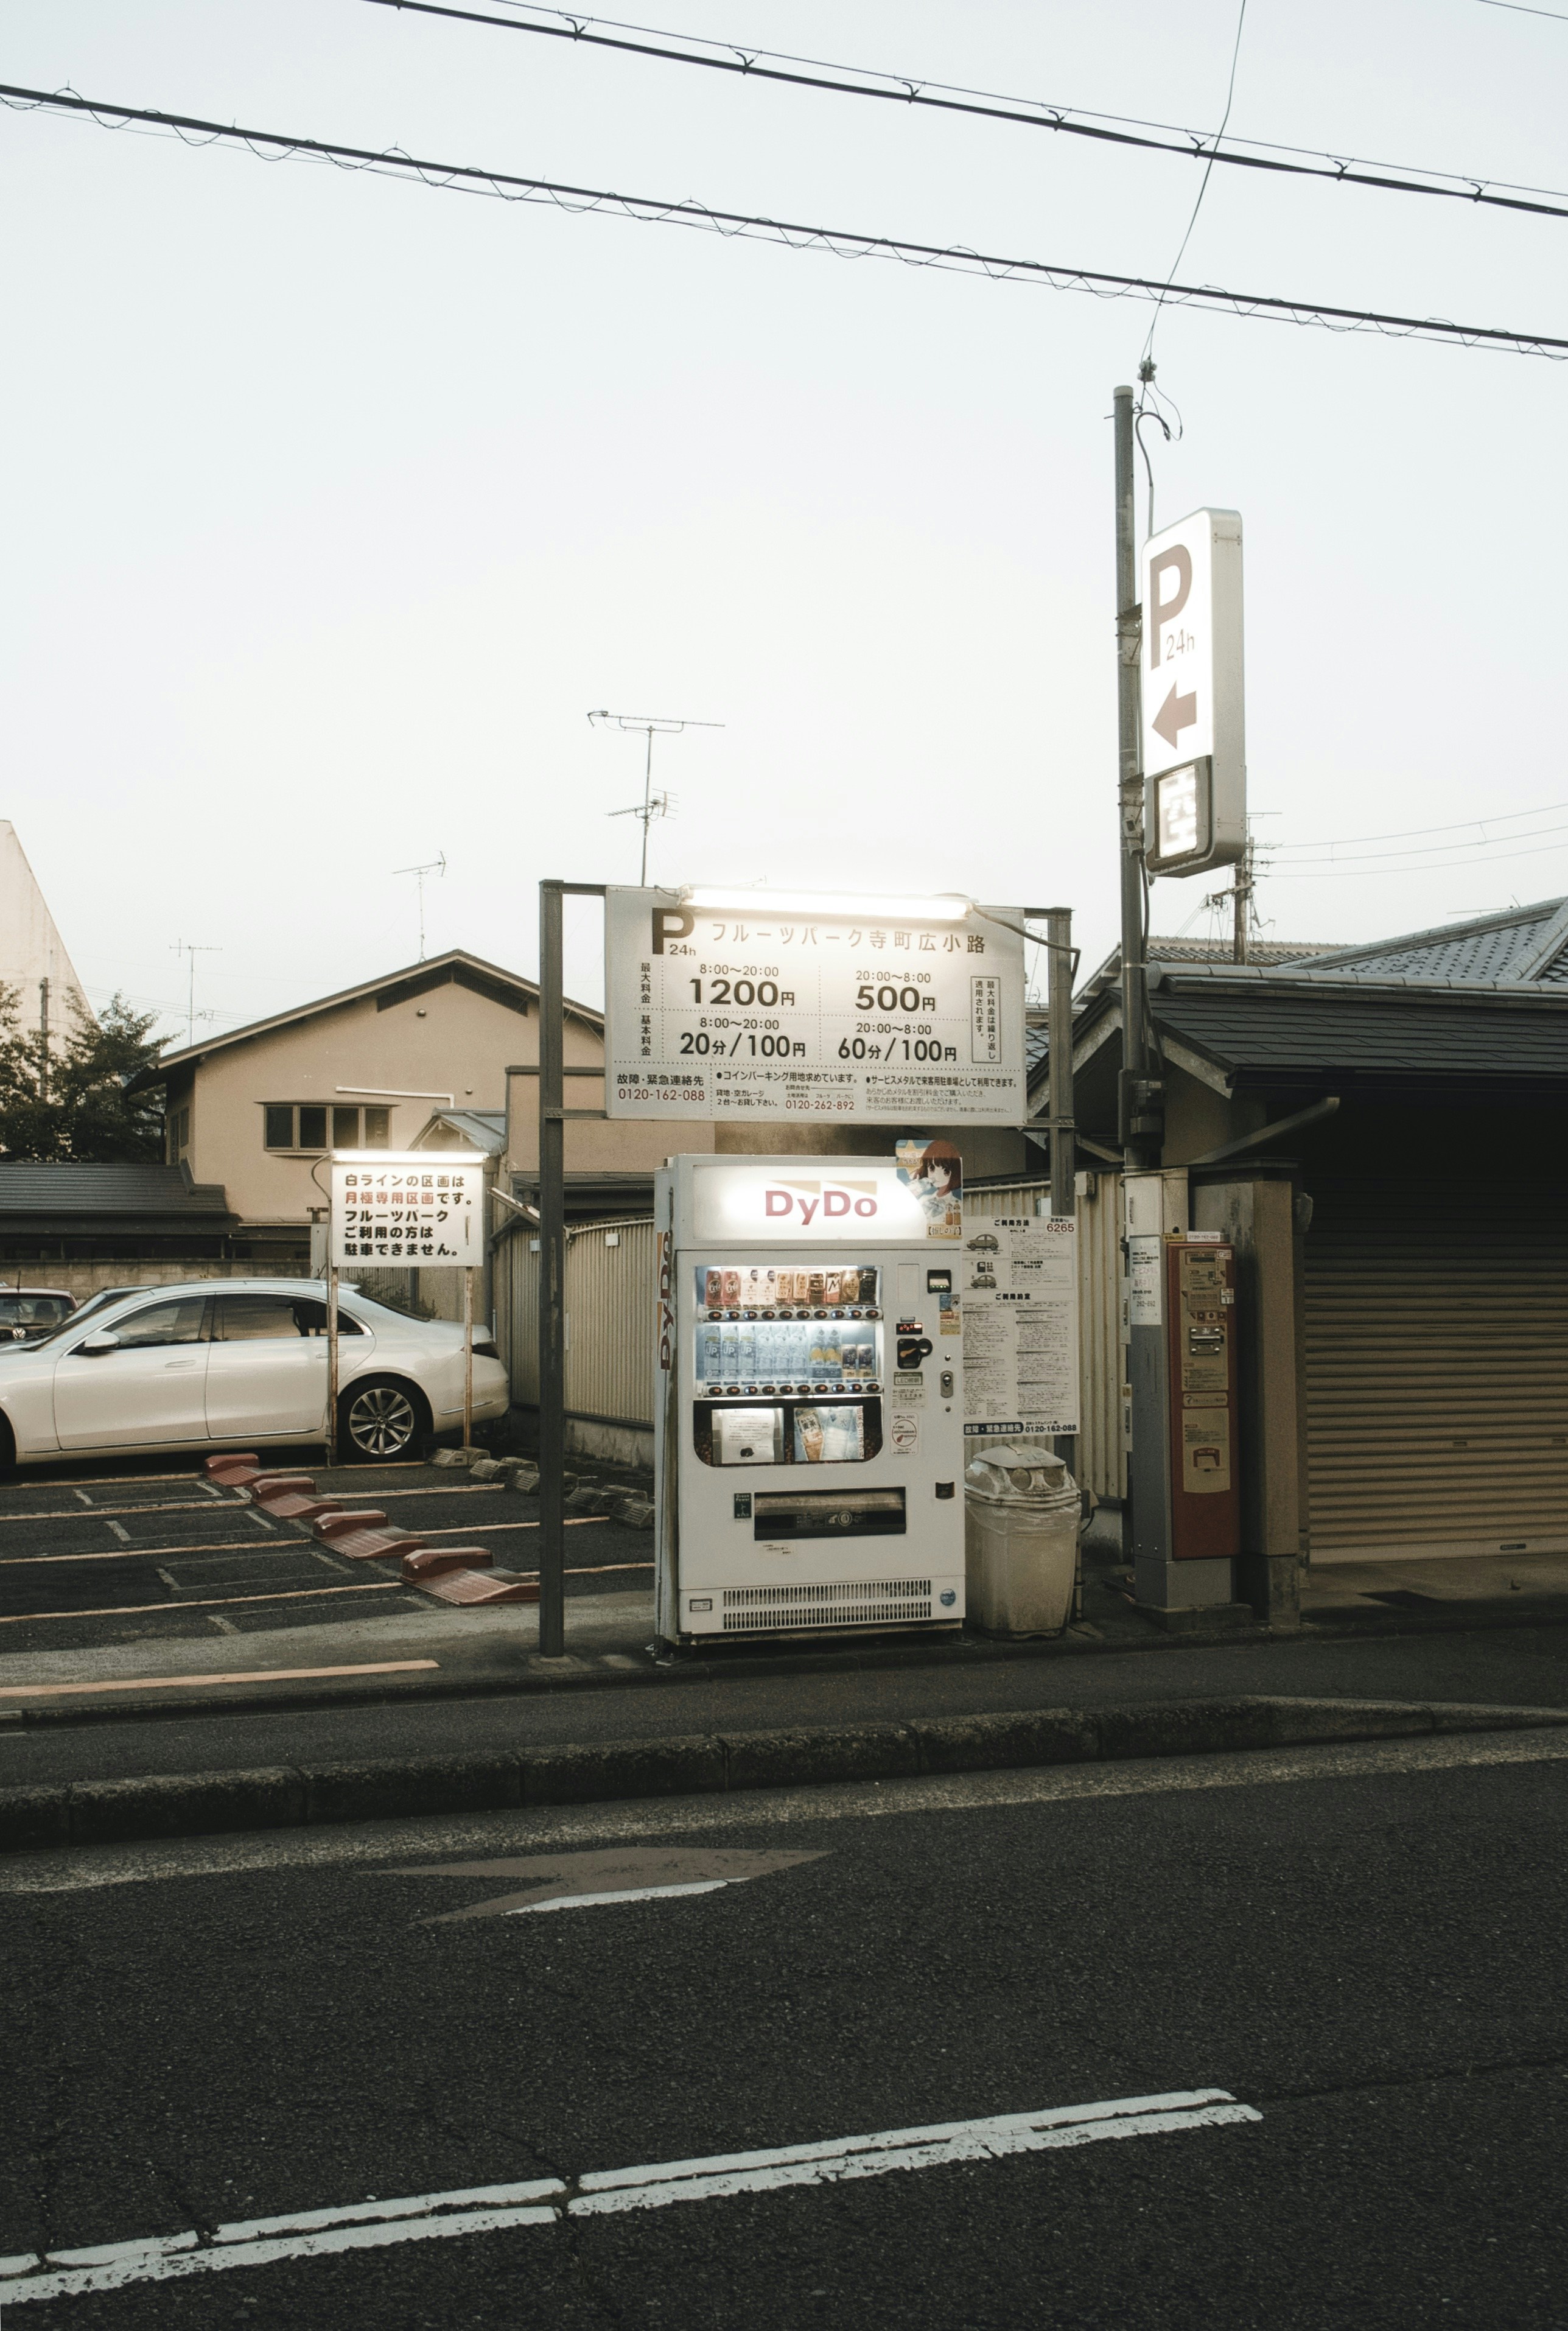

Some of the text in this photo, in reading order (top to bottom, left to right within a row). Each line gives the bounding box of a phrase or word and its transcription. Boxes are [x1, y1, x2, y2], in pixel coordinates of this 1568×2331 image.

[1149, 544, 1192, 671] P
[1166, 628, 1195, 661] 24h
[652, 907, 695, 955] P
[712, 922, 985, 955] フルーツパーク寺町広小路
[670, 944, 696, 956] 24h
[641, 962, 651, 1004] 最大料金
[689, 979, 795, 1008] 1200円
[855, 985, 936, 1013] 500円
[641, 1015, 651, 1056] 基本料金
[617, 1074, 704, 1086] 故障・緊急連絡先
[618, 1088, 705, 1101] 0120-162-088
[786, 1100, 855, 1110] 0120-262-892
[345, 1174, 464, 1188] 白ラインの区画は
[345, 1191, 471, 1205] 月極専用区画です。
[766, 1190, 878, 1225] DyDo
[345, 1208, 448, 1222] フルーツパーク
[345, 1226, 433, 1239] ご利用の方は
[1047, 1224, 1074, 1232] 6265
[345, 1243, 457, 1257] 駐車できません。
